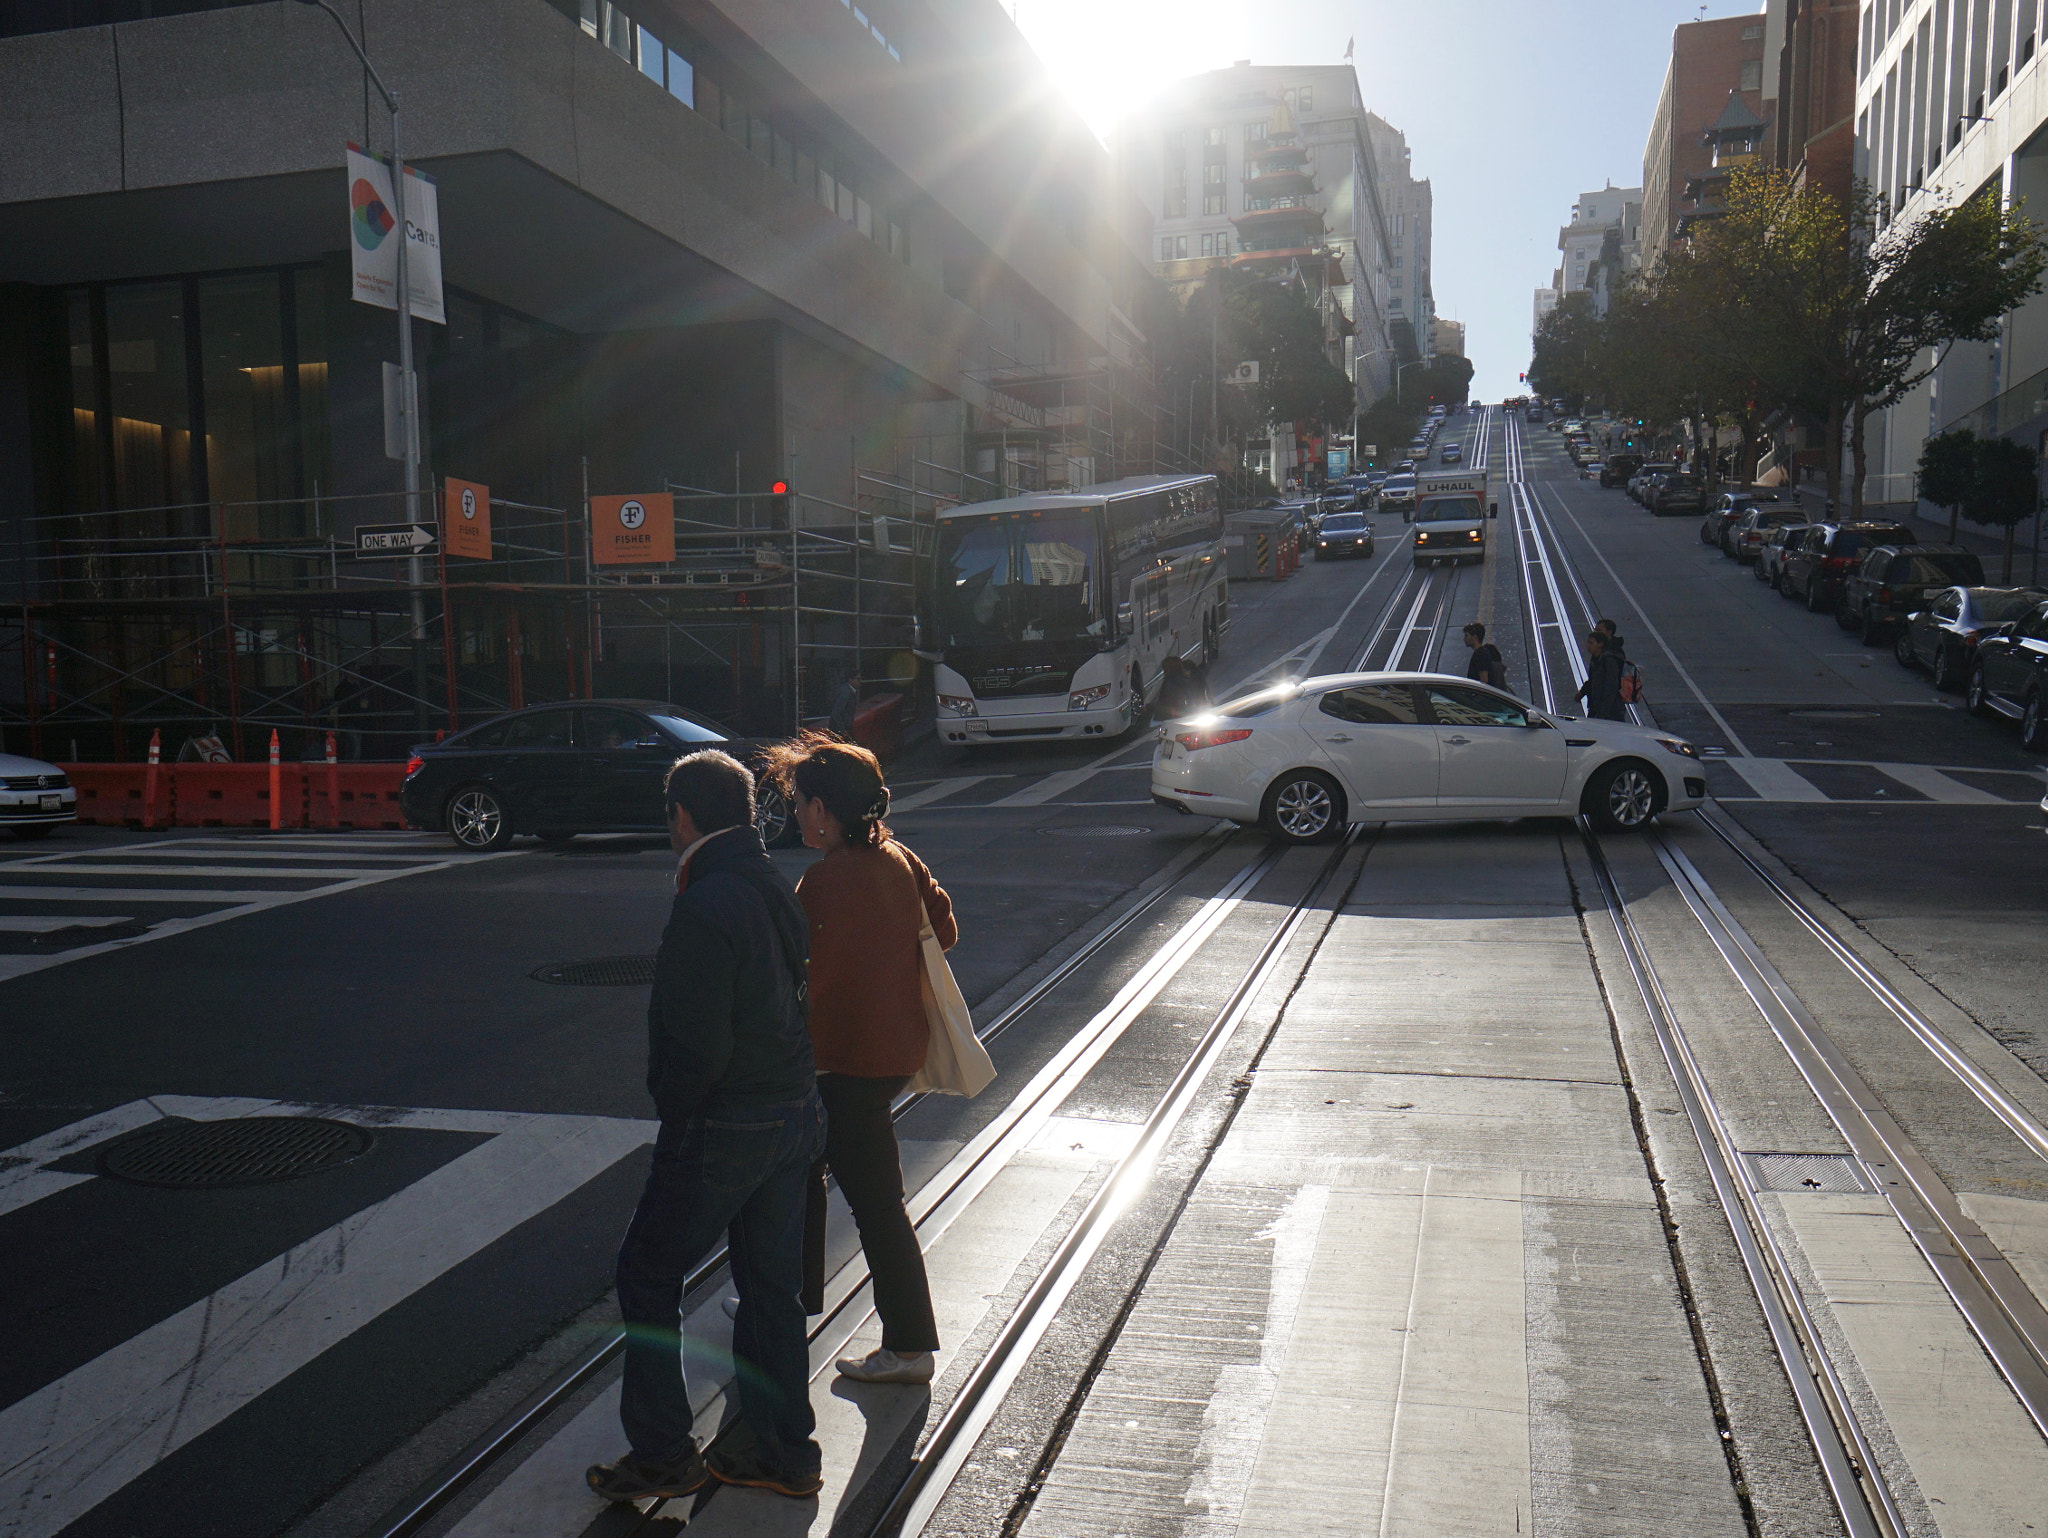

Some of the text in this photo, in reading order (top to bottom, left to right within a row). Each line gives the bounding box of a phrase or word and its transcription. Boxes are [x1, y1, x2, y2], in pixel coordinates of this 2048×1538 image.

[405, 219, 439, 249] Care.
[1427, 482, 1475, 492] U-HAUL
[459, 524, 480, 537] FISHER
[364, 534, 414, 548] ONE WAY
[615, 535, 651, 544] FISHER
[973, 676, 1012, 689] TCS
